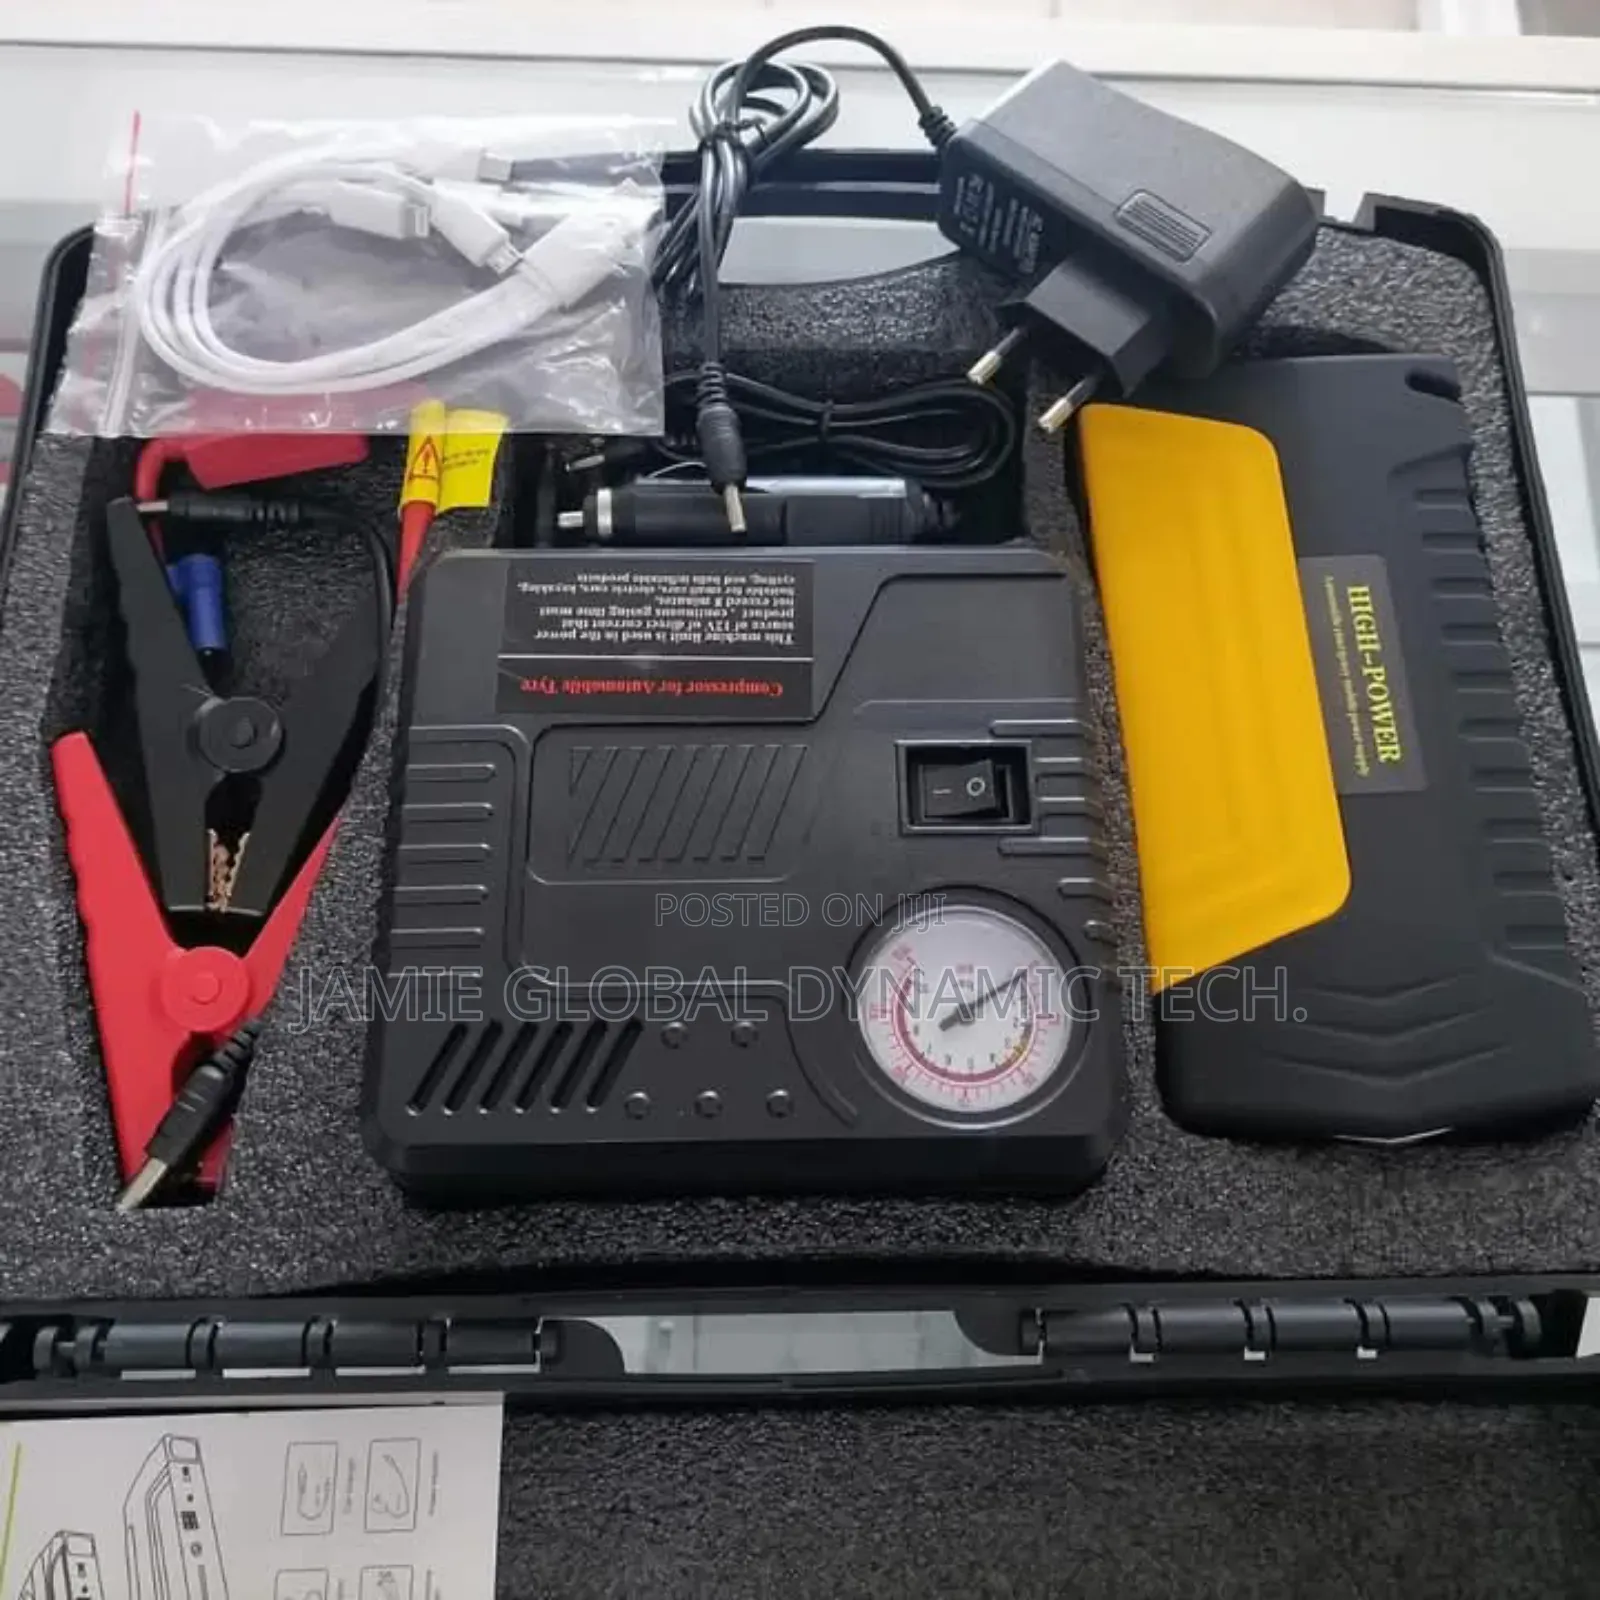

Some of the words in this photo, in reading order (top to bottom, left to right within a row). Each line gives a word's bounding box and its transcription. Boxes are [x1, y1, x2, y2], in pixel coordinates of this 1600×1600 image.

[726, 597, 770, 608] exceed
[773, 597, 795, 608] not
[655, 608, 728, 619] continuous
[741, 608, 795, 620] product
[561, 619, 590, 629] that
[592, 619, 643, 630] current
[646, 620, 685, 631] direct
[688, 620, 702, 631] of
[709, 620, 731, 632] 12V
[735, 621, 748, 632] of
[752, 621, 795, 631] source
[534, 629, 577, 640] power
[580, 630, 601, 642] the
[605, 631, 618, 642] in
[622, 631, 652, 642] used
[656, 632, 667, 643] is
[670, 632, 702, 644] limit
[705, 632, 761, 644] machine
[764, 632, 794, 645] This
[1347, 586, 1401, 763] HIGH-POWER
[520, 678, 558, 695] Tyre
[562, 679, 657, 696] Automobile
[658, 680, 683, 697] for
[686, 679, 783, 698] Compressor
